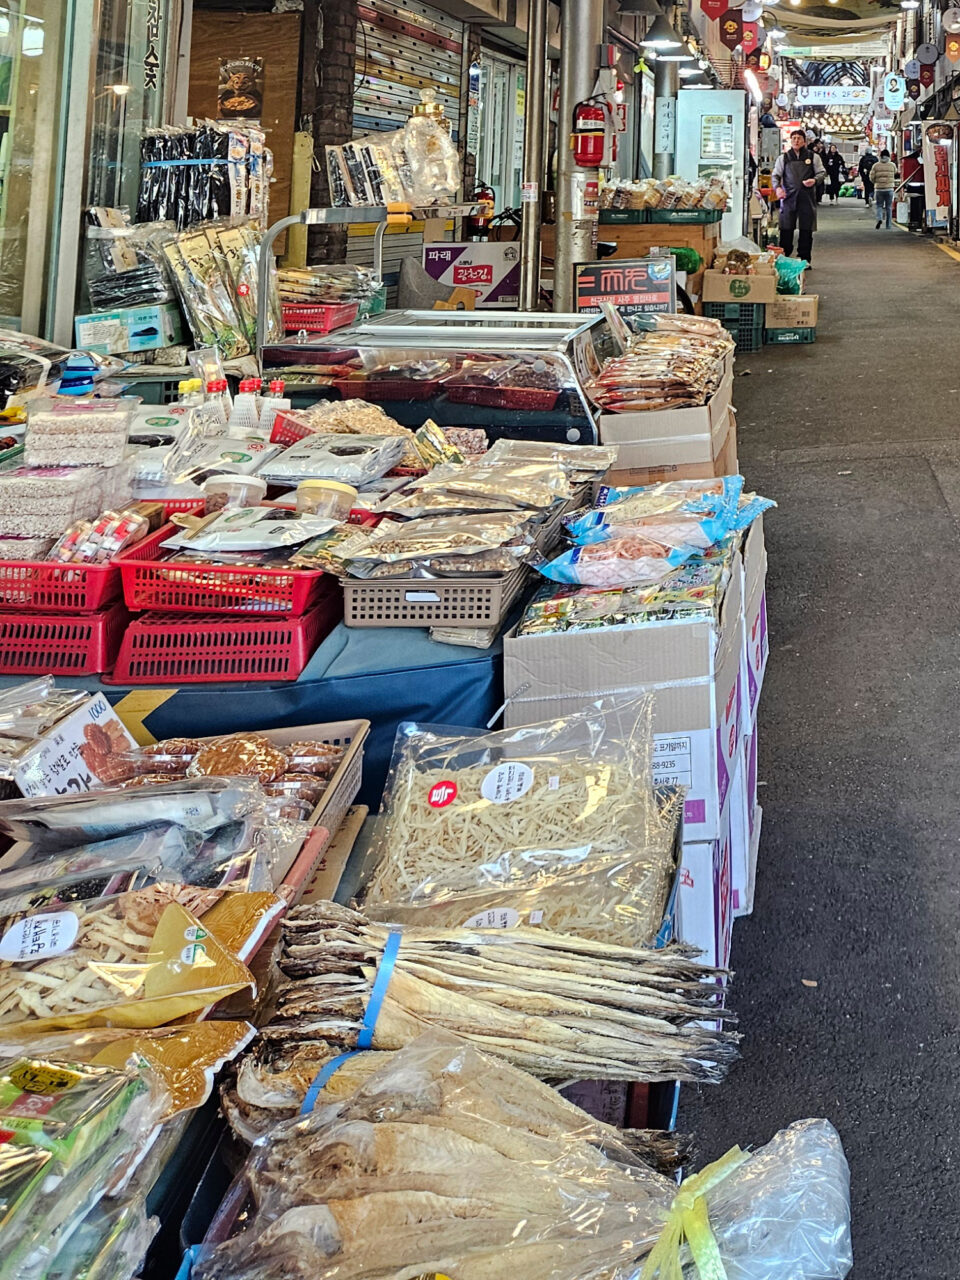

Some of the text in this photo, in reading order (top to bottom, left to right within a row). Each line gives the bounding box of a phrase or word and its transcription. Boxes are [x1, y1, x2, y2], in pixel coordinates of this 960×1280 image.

[428, 250, 451, 261] 파래
[457, 268, 488, 281] 광천김
[88, 700, 107, 721] 1000
[29, 919, 47, 954] 황태채
